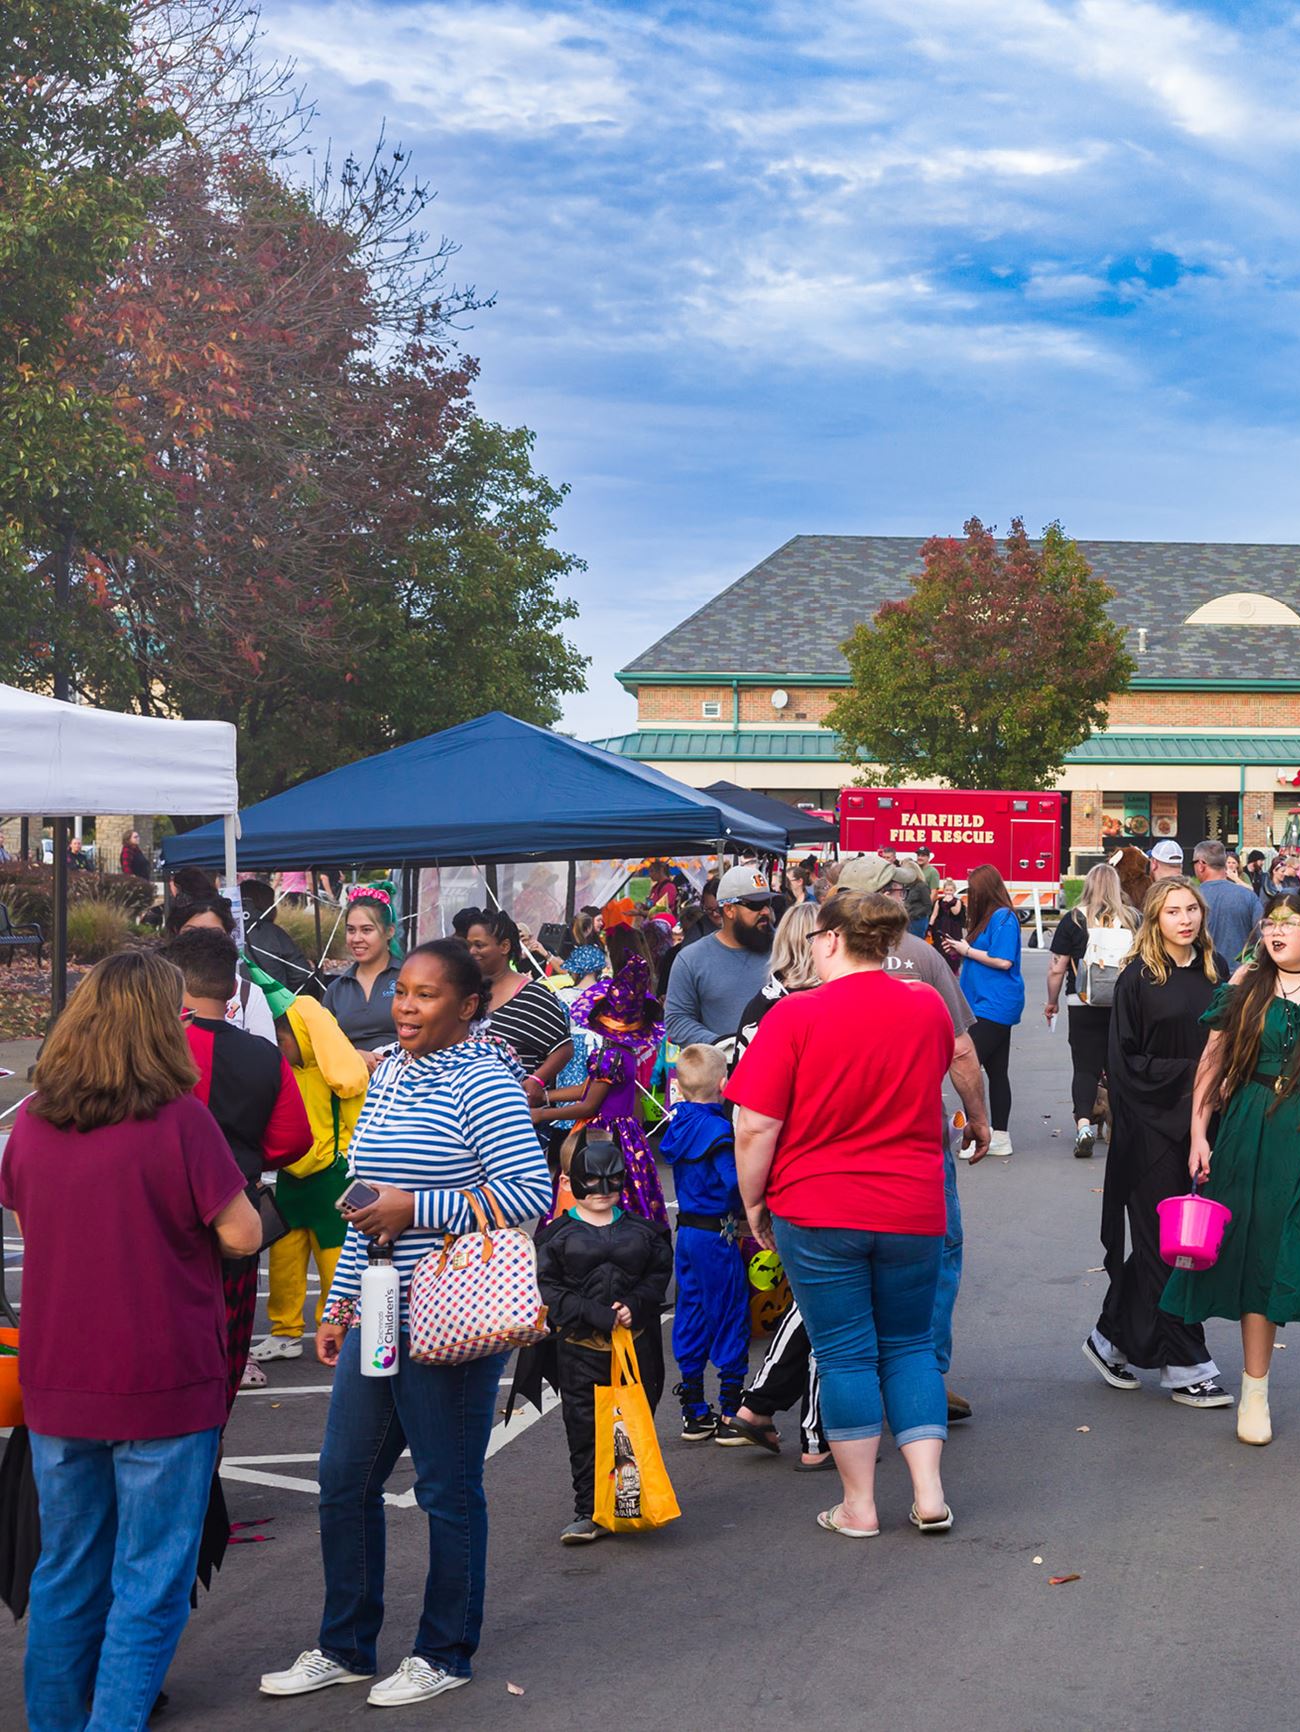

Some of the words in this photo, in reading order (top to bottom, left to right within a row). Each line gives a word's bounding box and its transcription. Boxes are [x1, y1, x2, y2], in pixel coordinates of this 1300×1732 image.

[901, 813, 985, 828] FAIRFIELD
[889, 829, 926, 842] FIRE
[931, 830, 995, 844] RESCUE
[384, 1288, 394, 1344] Children's
